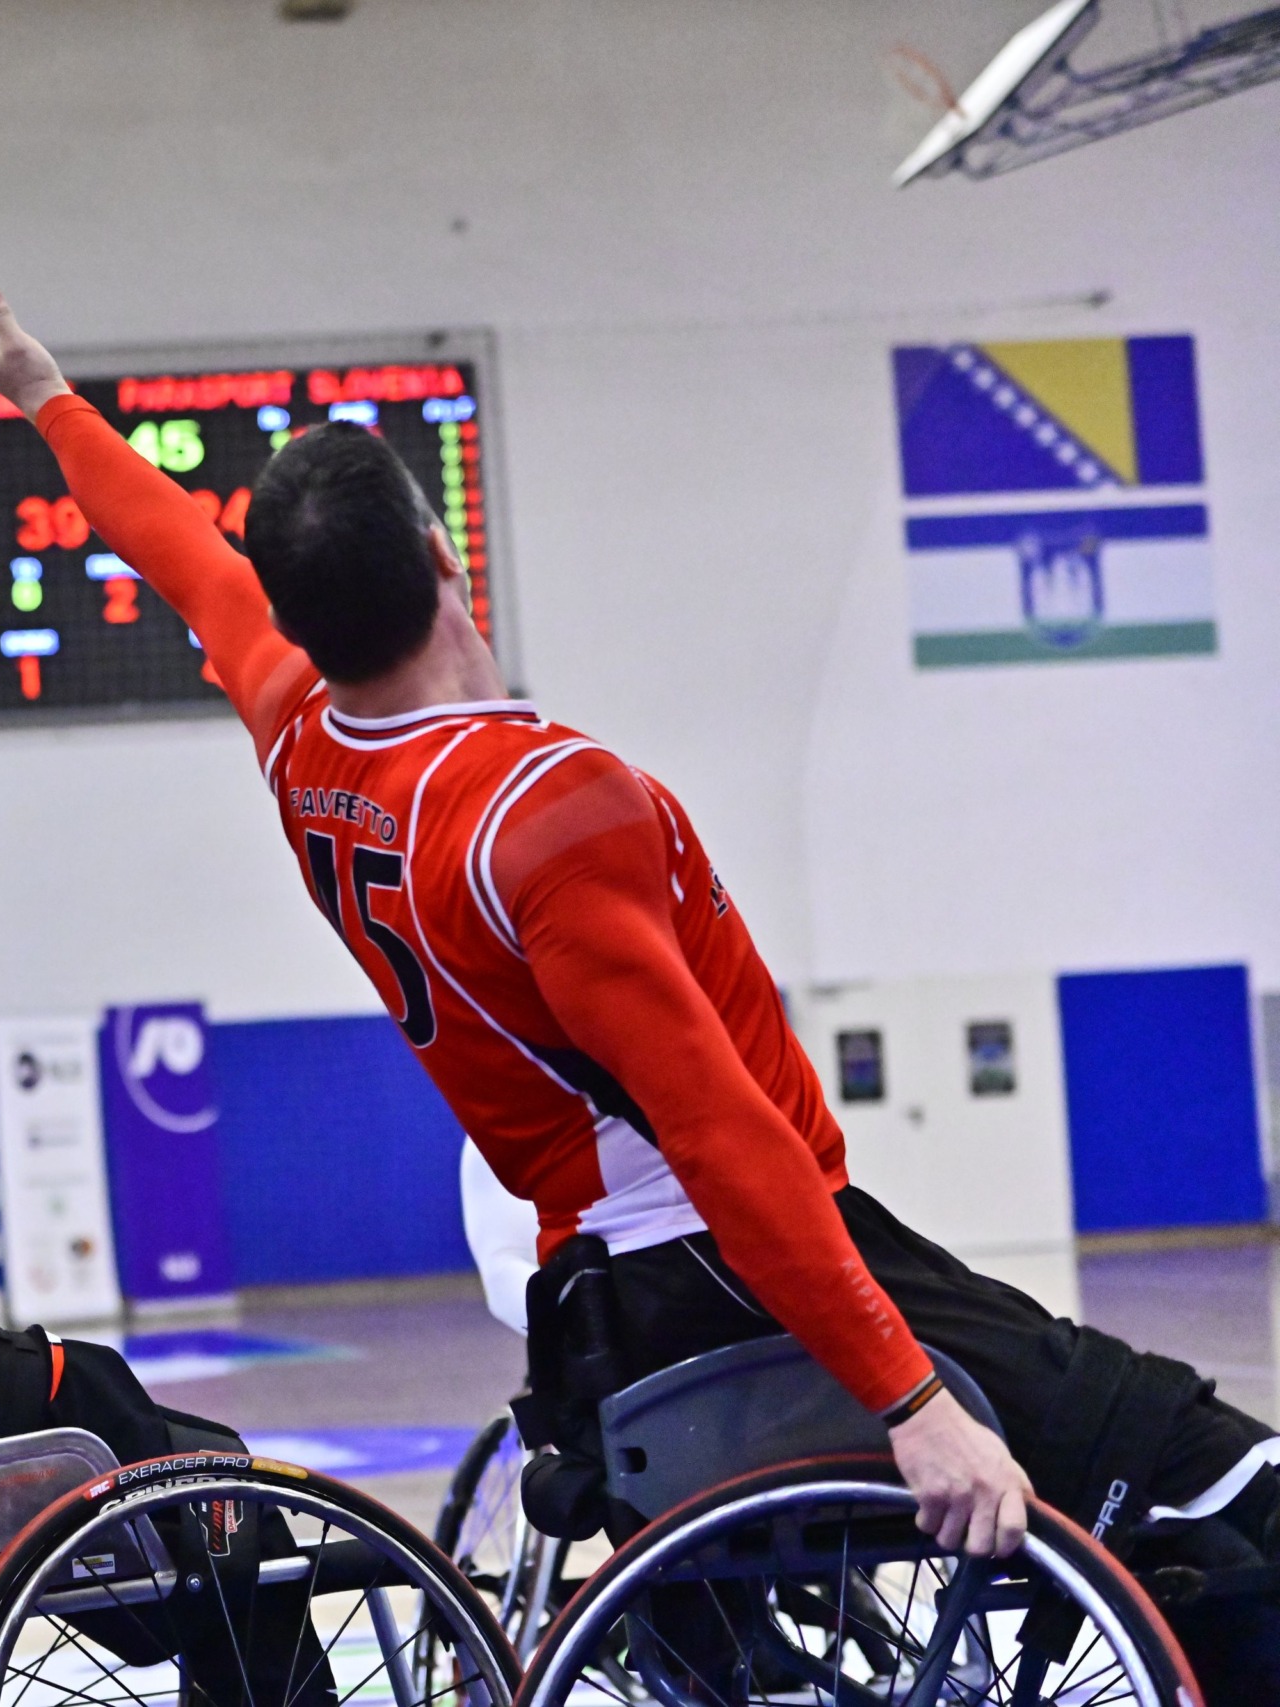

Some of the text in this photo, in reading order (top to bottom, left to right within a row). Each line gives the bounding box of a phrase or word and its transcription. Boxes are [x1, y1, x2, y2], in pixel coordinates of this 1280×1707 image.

[289, 786, 398, 845] FAVRETTO
[304, 827, 438, 1050] 15
[841, 1257, 895, 1341] KIPSTA
[118, 1457, 207, 1485] EXERACER
[212, 1456, 249, 1468] PRO
[1090, 1479, 1129, 1541] PRO
